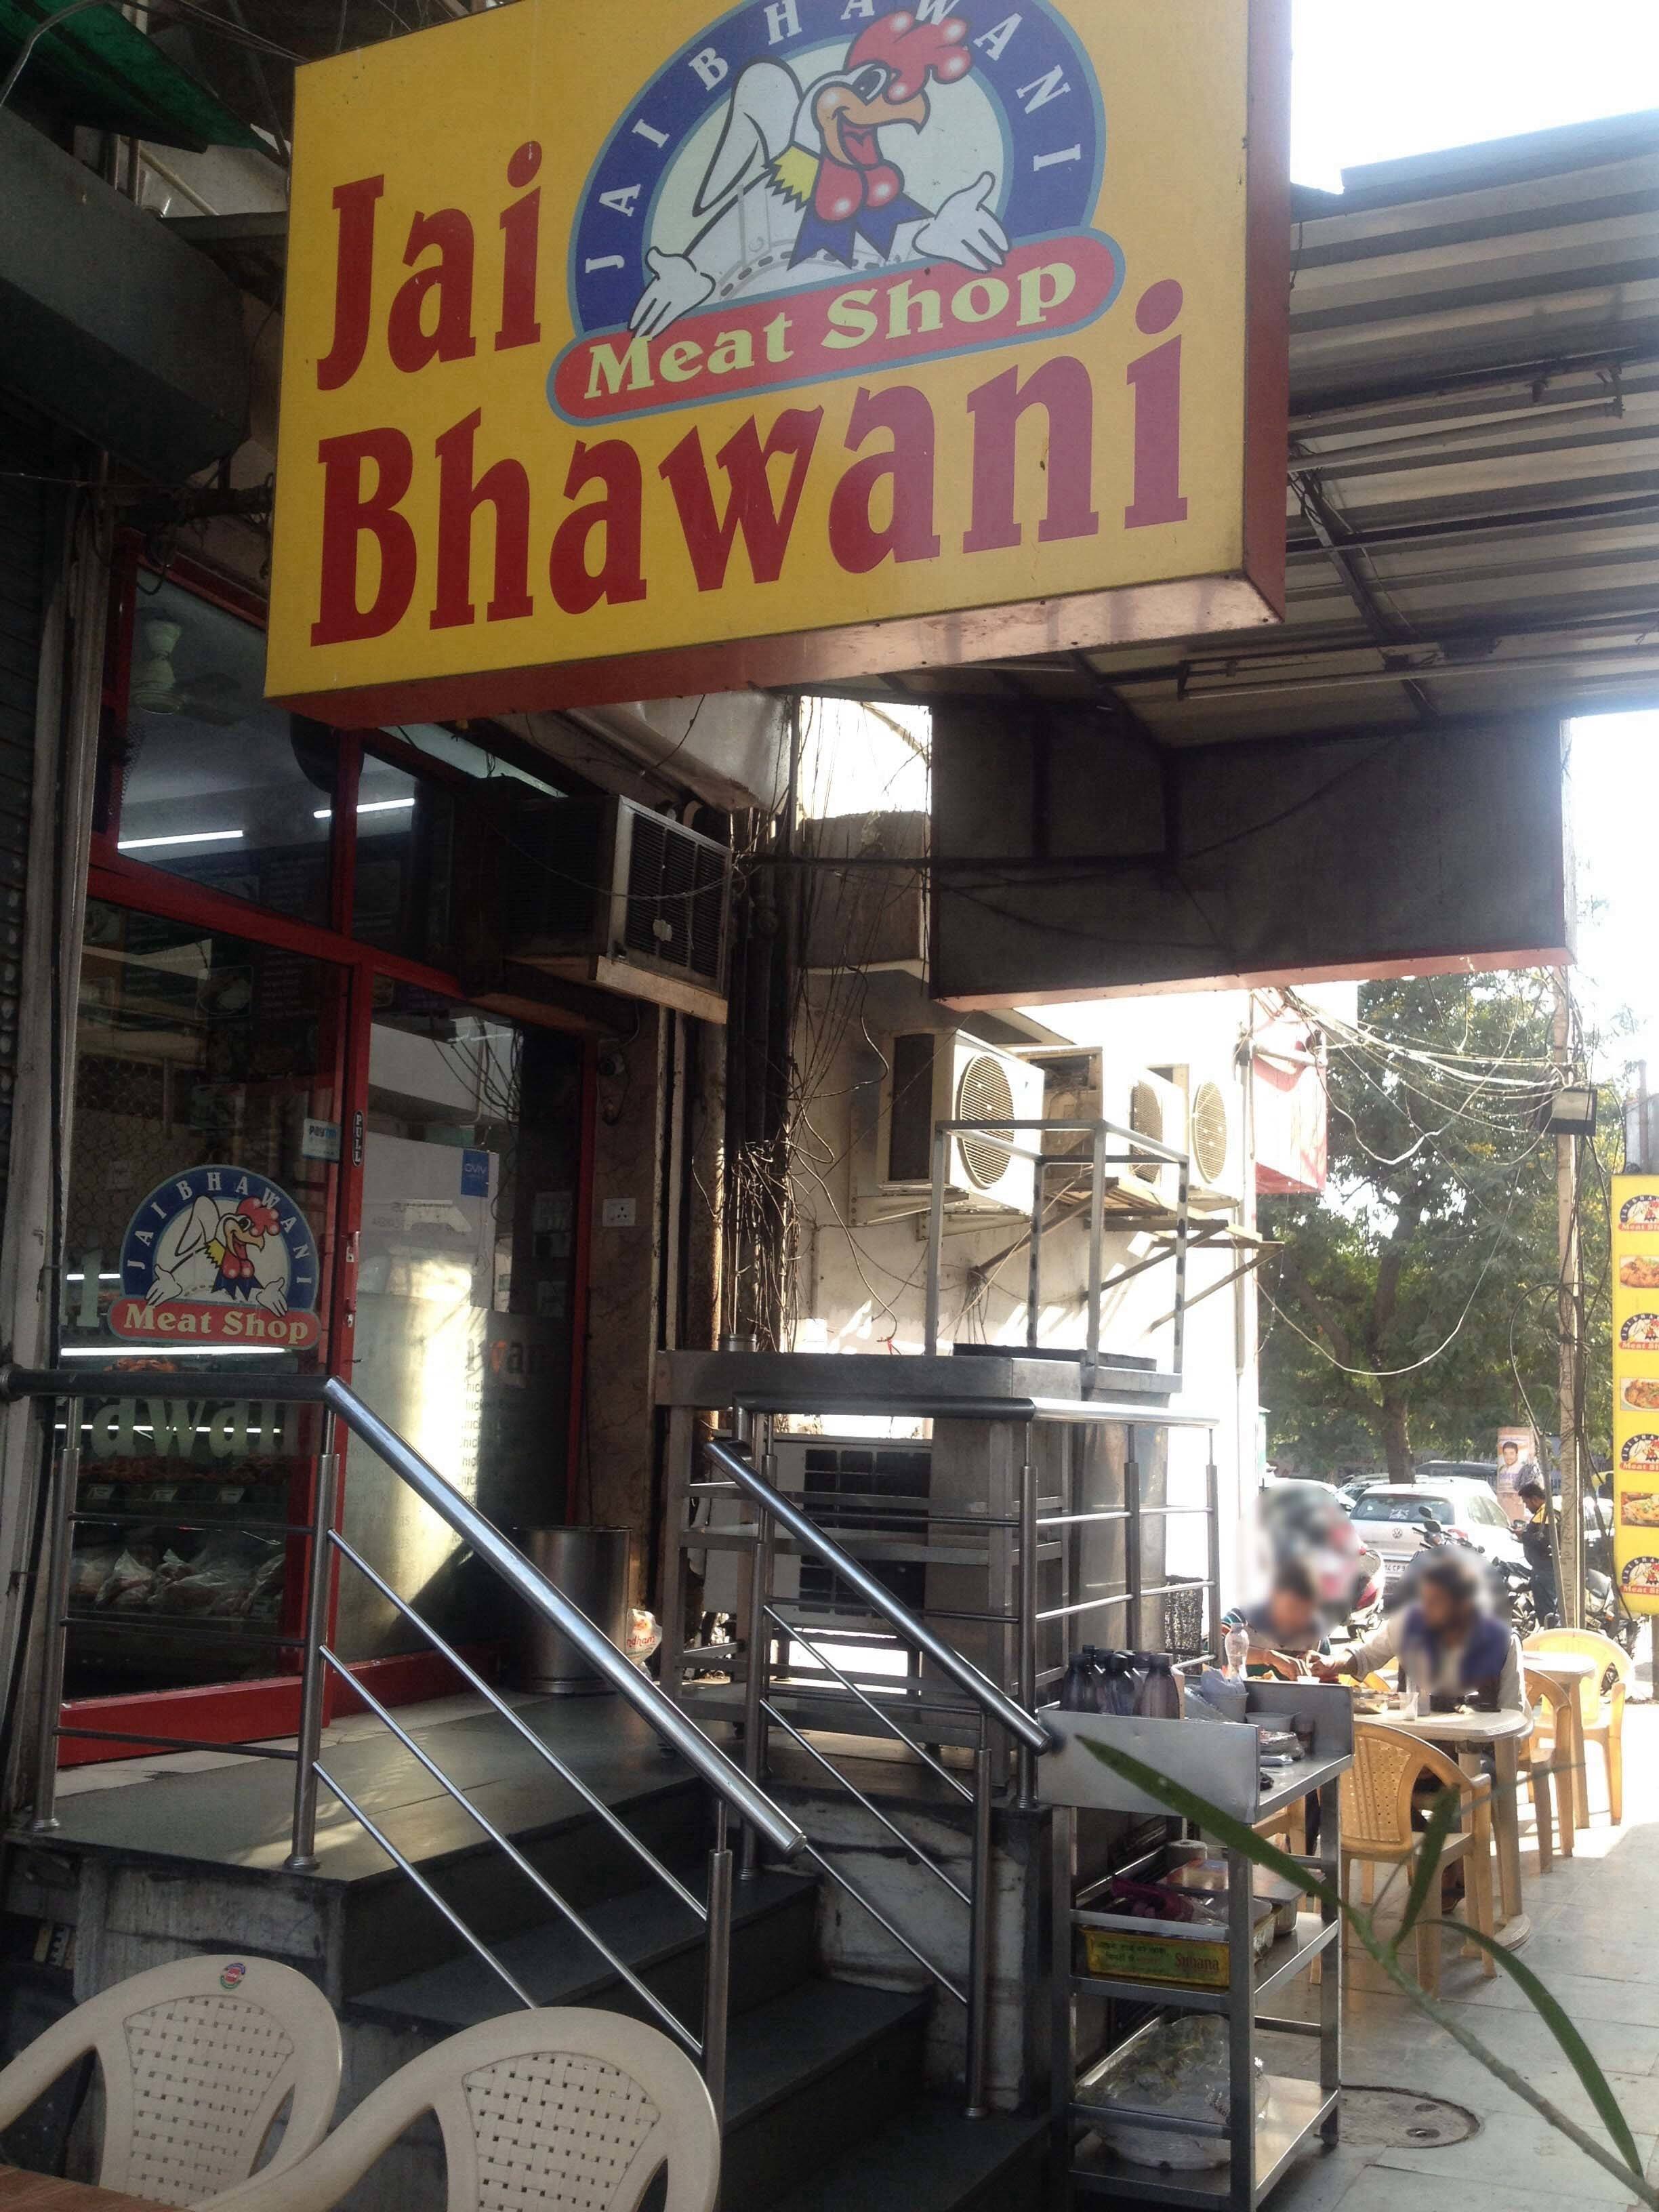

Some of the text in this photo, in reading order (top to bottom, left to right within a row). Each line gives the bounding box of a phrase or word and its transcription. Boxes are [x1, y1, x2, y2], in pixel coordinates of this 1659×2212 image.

[316, 140, 543, 391] Jai
[585, 118, 671, 274] JAI
[583, 261, 1078, 398] Meat Shop
[310, 279, 1189, 647] Bhawani
[127, 1202, 167, 1270] JAI
[176, 1172, 312, 1285] BHAWANI
[123, 1303, 308, 1345] Meat Shop
